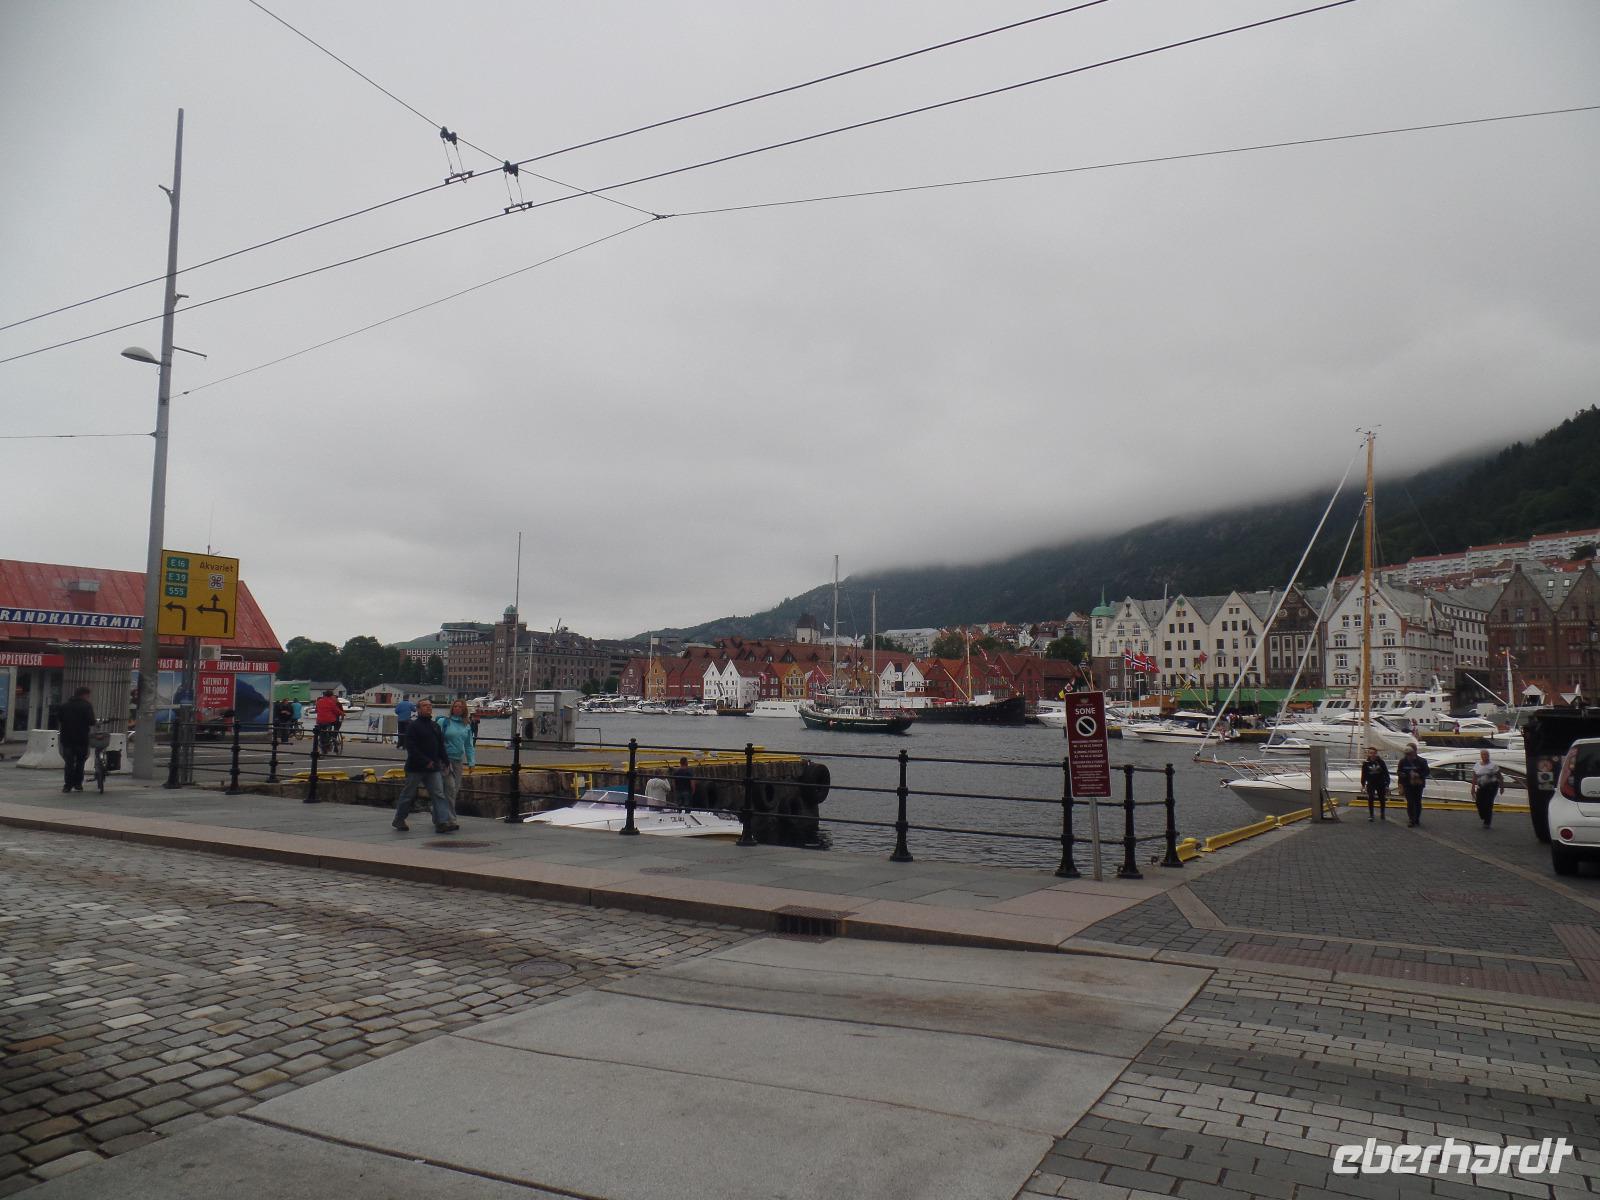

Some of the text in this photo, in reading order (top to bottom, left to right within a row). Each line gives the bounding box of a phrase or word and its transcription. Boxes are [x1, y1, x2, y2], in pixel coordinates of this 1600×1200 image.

[200, 561, 234, 573] Akvariet
[169, 587, 184, 596] 555
[1075, 707, 1096, 715] SONE
